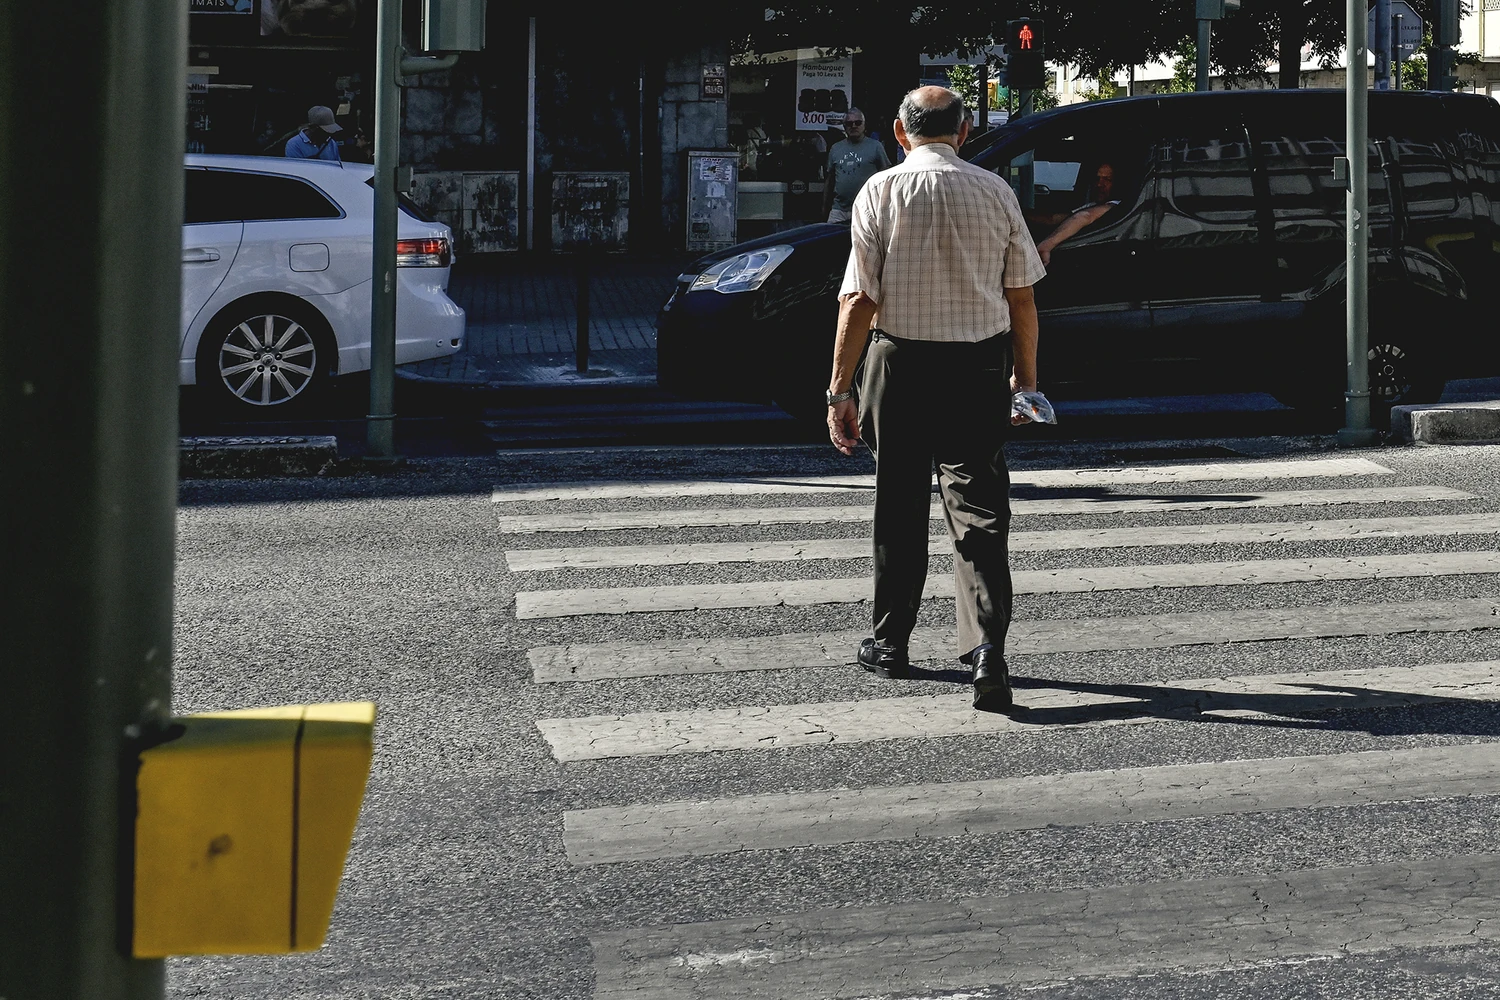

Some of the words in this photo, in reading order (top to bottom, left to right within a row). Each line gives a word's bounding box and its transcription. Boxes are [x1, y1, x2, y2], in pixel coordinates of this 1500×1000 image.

[802, 63, 845, 72] Hamburguer
[802, 112, 825, 124] 8.00
[839, 151, 862, 164] DENIM
